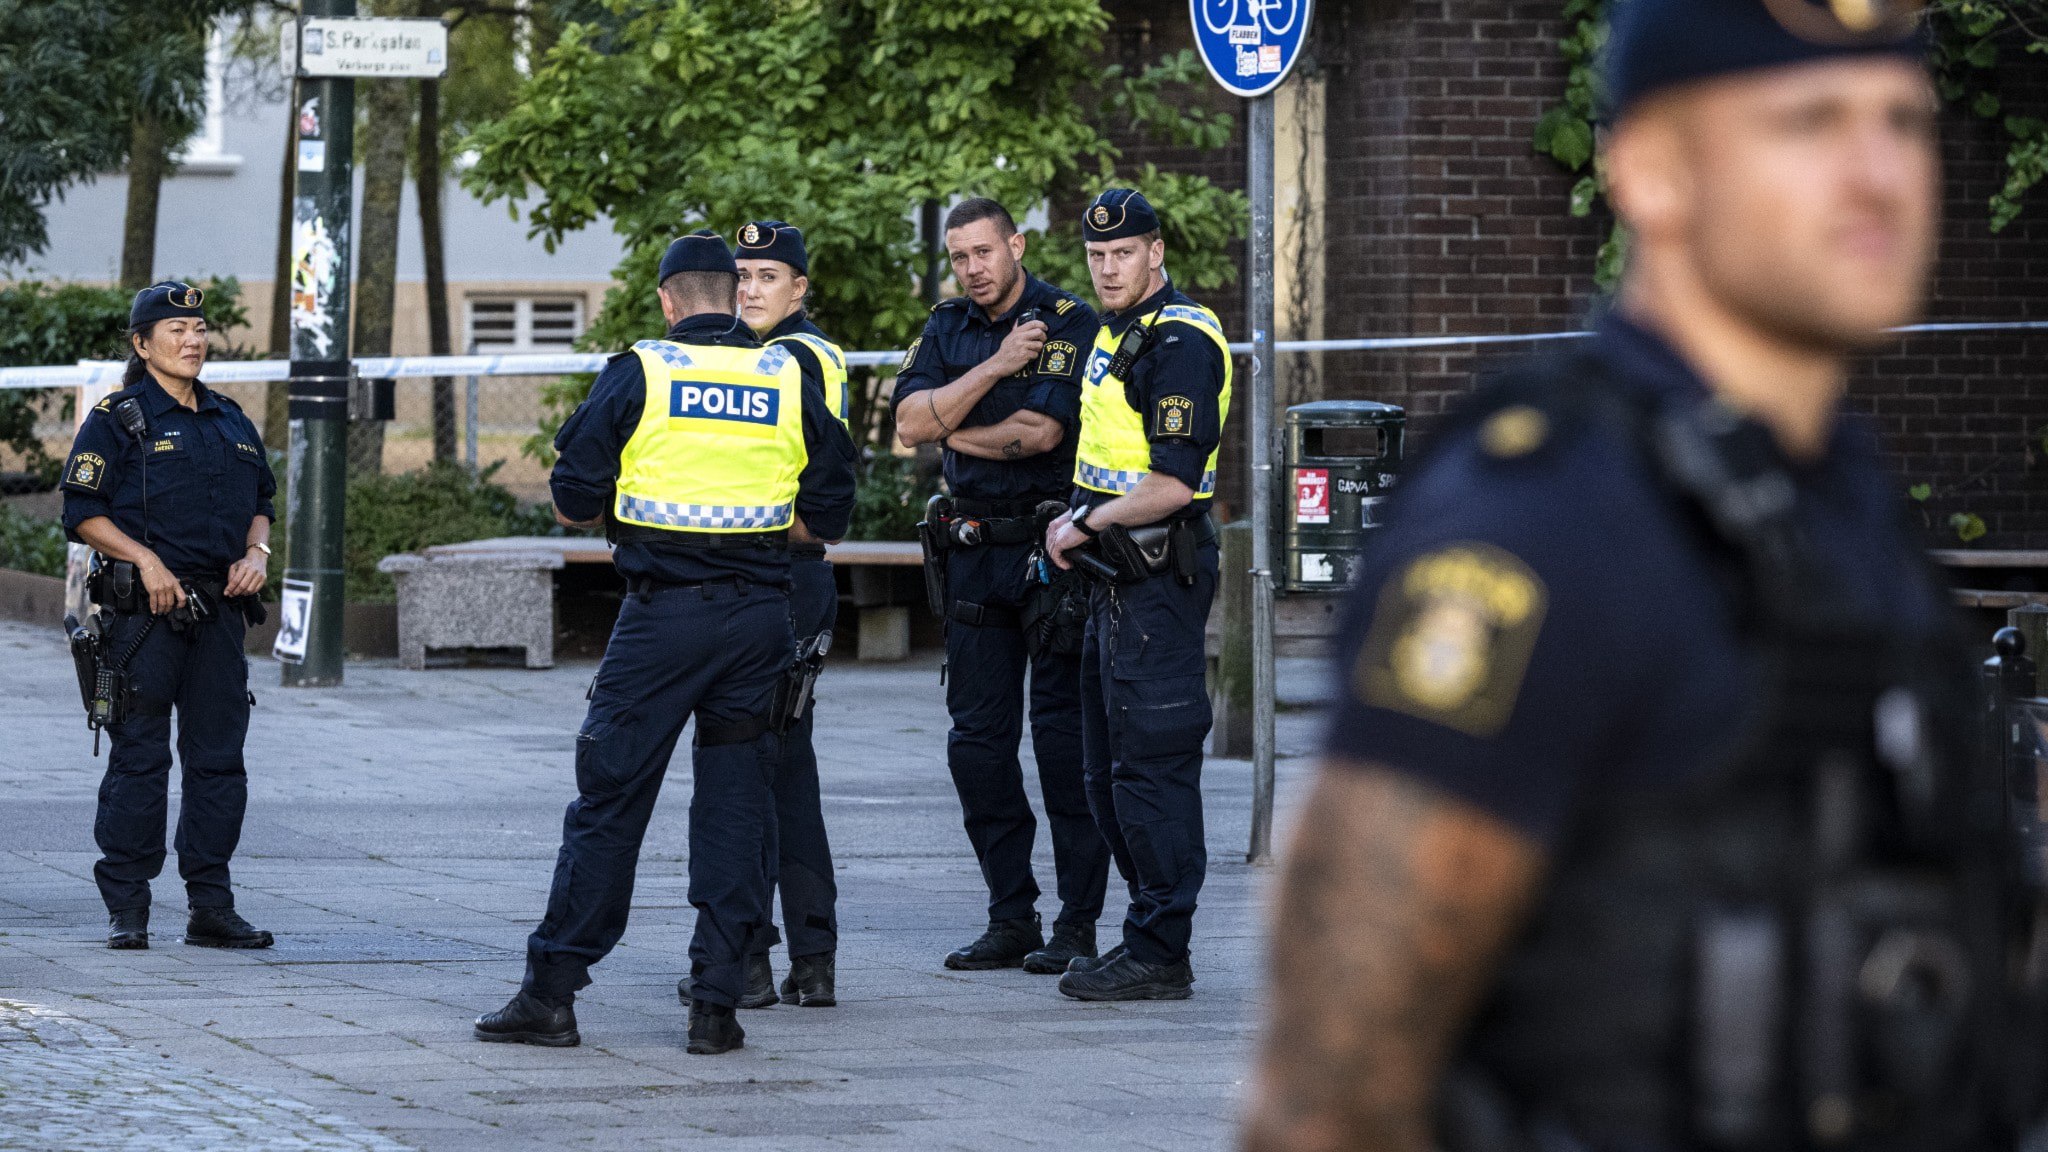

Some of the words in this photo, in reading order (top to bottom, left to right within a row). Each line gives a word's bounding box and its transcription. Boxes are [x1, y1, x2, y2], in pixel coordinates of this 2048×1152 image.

[1046, 342, 1074, 354] POLIS
[681, 386, 769, 418] POLIS
[1161, 398, 1191, 410] POLIS
[77, 454, 103, 466] POLIS
